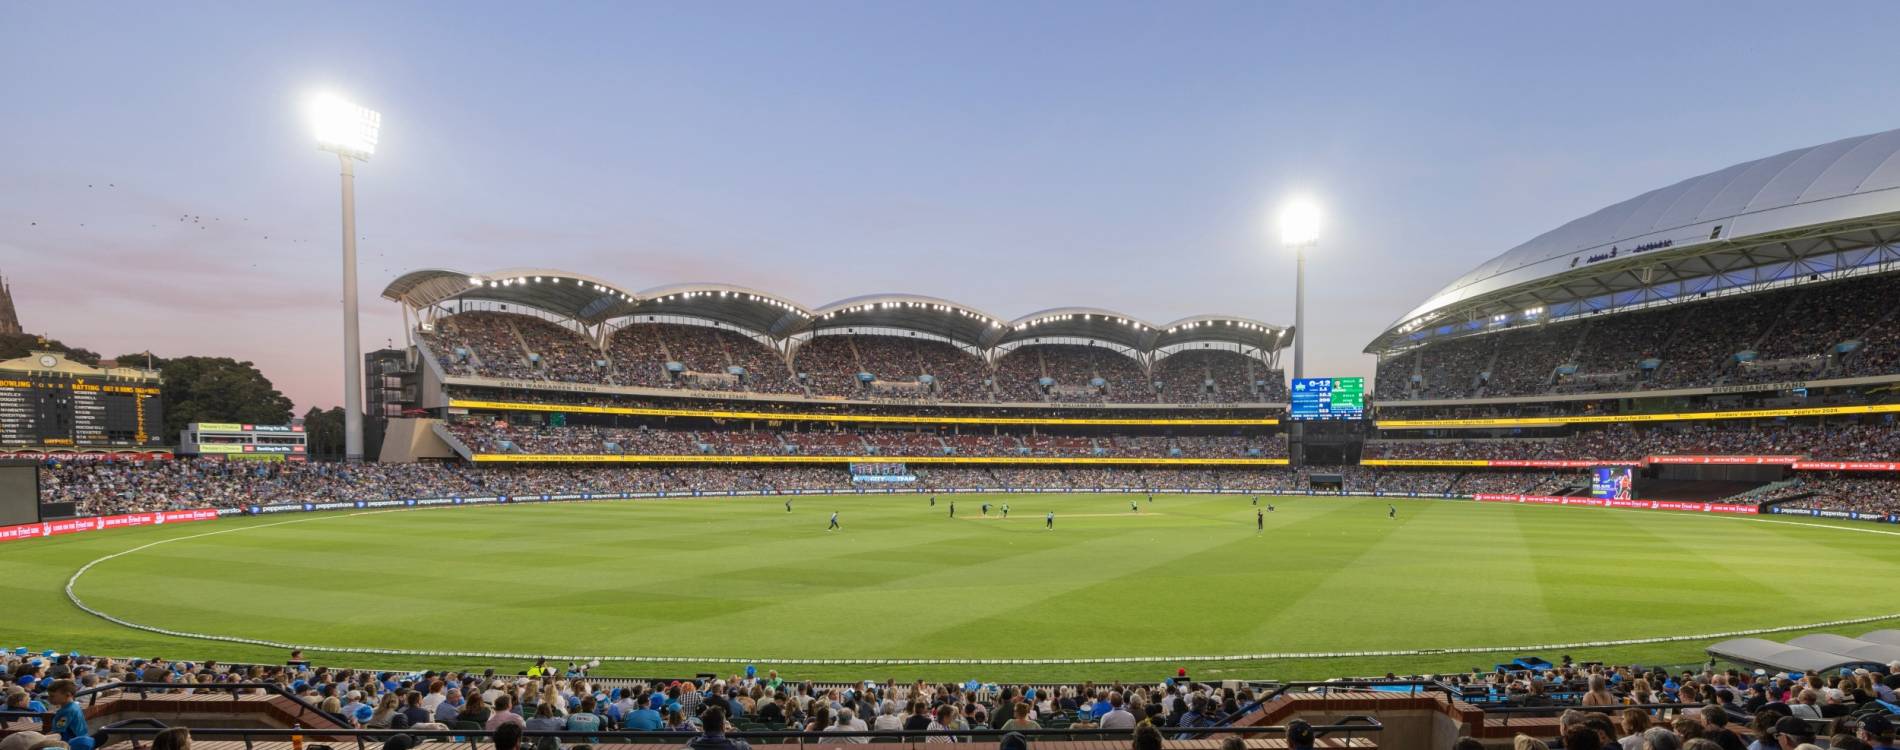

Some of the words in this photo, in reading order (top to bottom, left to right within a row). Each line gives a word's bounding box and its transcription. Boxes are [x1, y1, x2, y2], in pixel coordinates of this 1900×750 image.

[72, 383, 100, 391] BATTING
[1712, 384, 1769, 393] RIVERBANK
[1773, 381, 1806, 390] STAND
[262, 504, 302, 512] pepperstone
